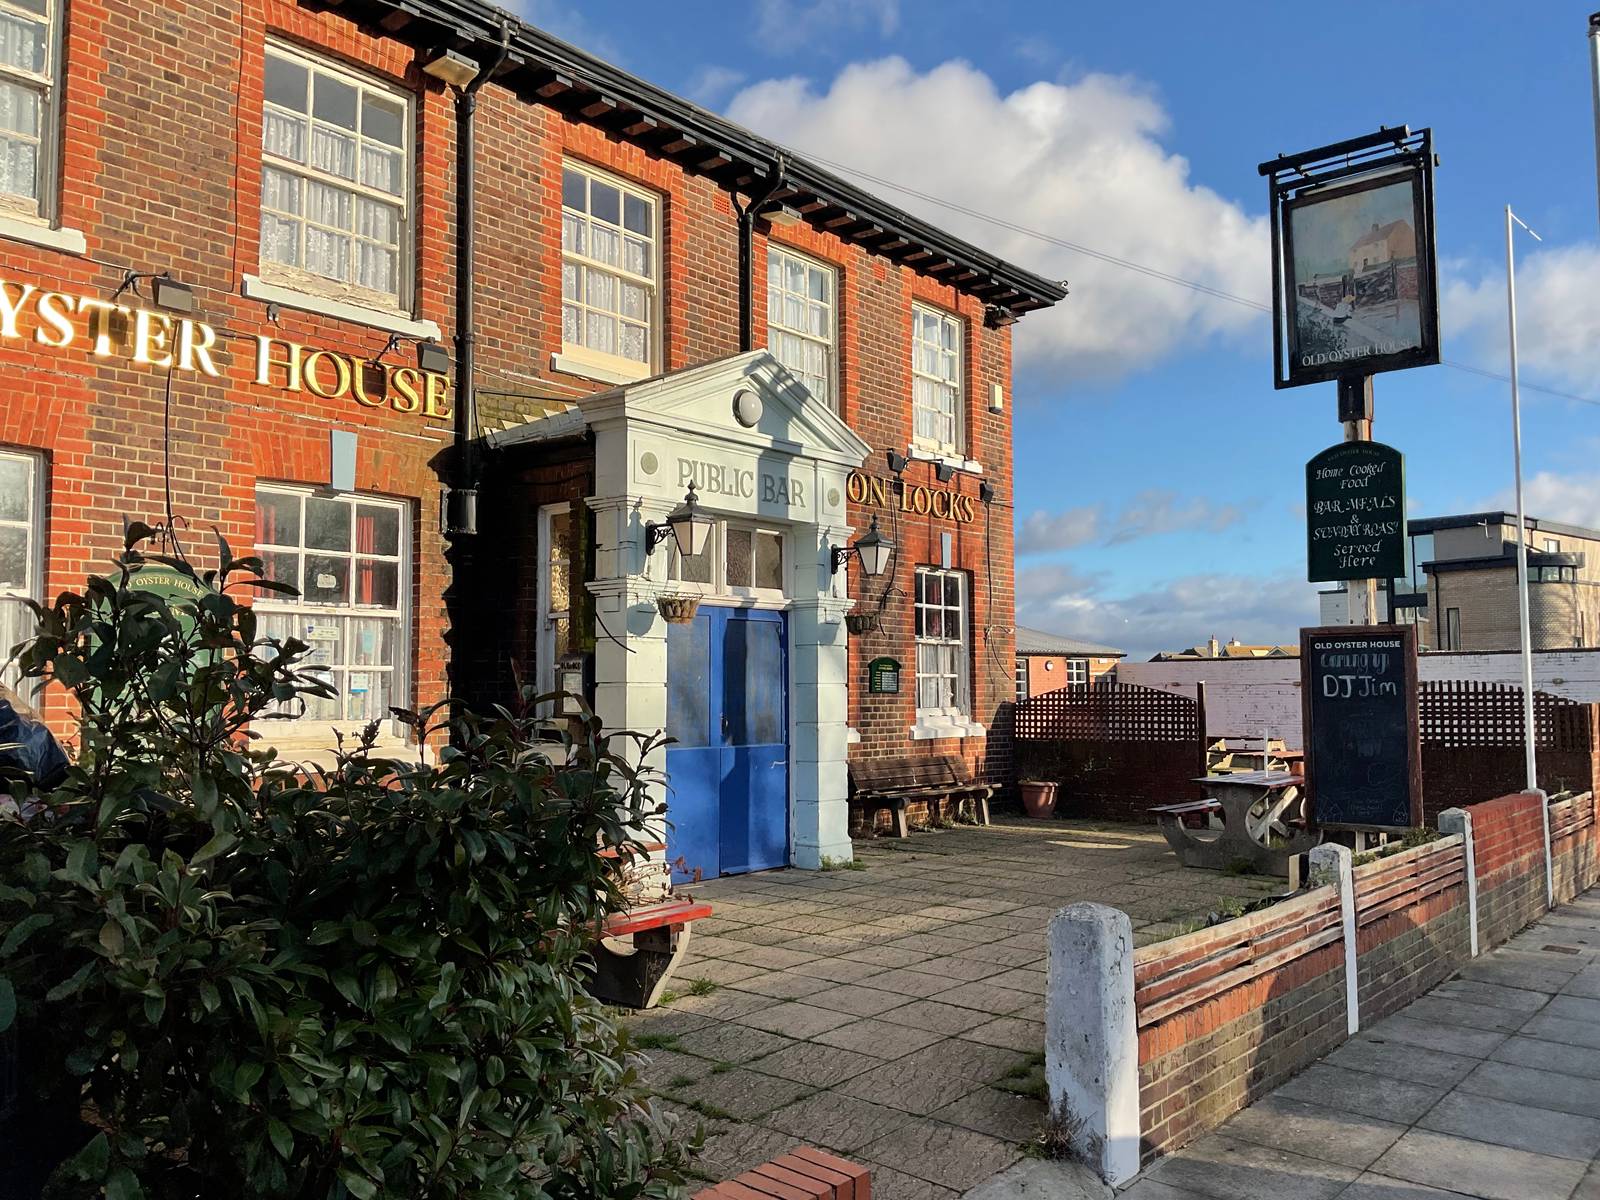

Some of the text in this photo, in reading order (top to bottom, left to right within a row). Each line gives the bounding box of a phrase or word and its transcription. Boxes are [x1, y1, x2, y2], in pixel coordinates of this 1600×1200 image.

[1302, 339, 1411, 367] OLD OYSTER HOUSE
[252, 335, 453, 419] HOUSE
[677, 458, 806, 508] PUBLIC BAR
[901, 482, 976, 524] LOCKS
[1313, 495, 1396, 515] BAR MEALS
[1350, 514, 1360, 524] &
[1313, 524, 1362, 541] SUNDAY
[1333, 539, 1383, 557] Served
[1339, 555, 1376, 569] Here
[135, 576, 170, 586] OYSTER
[173, 579, 204, 597] HOUSE
[1314, 640, 1401, 650] OLD OYSTER HOUSE
[1322, 674, 1397, 698] DJ Jim
